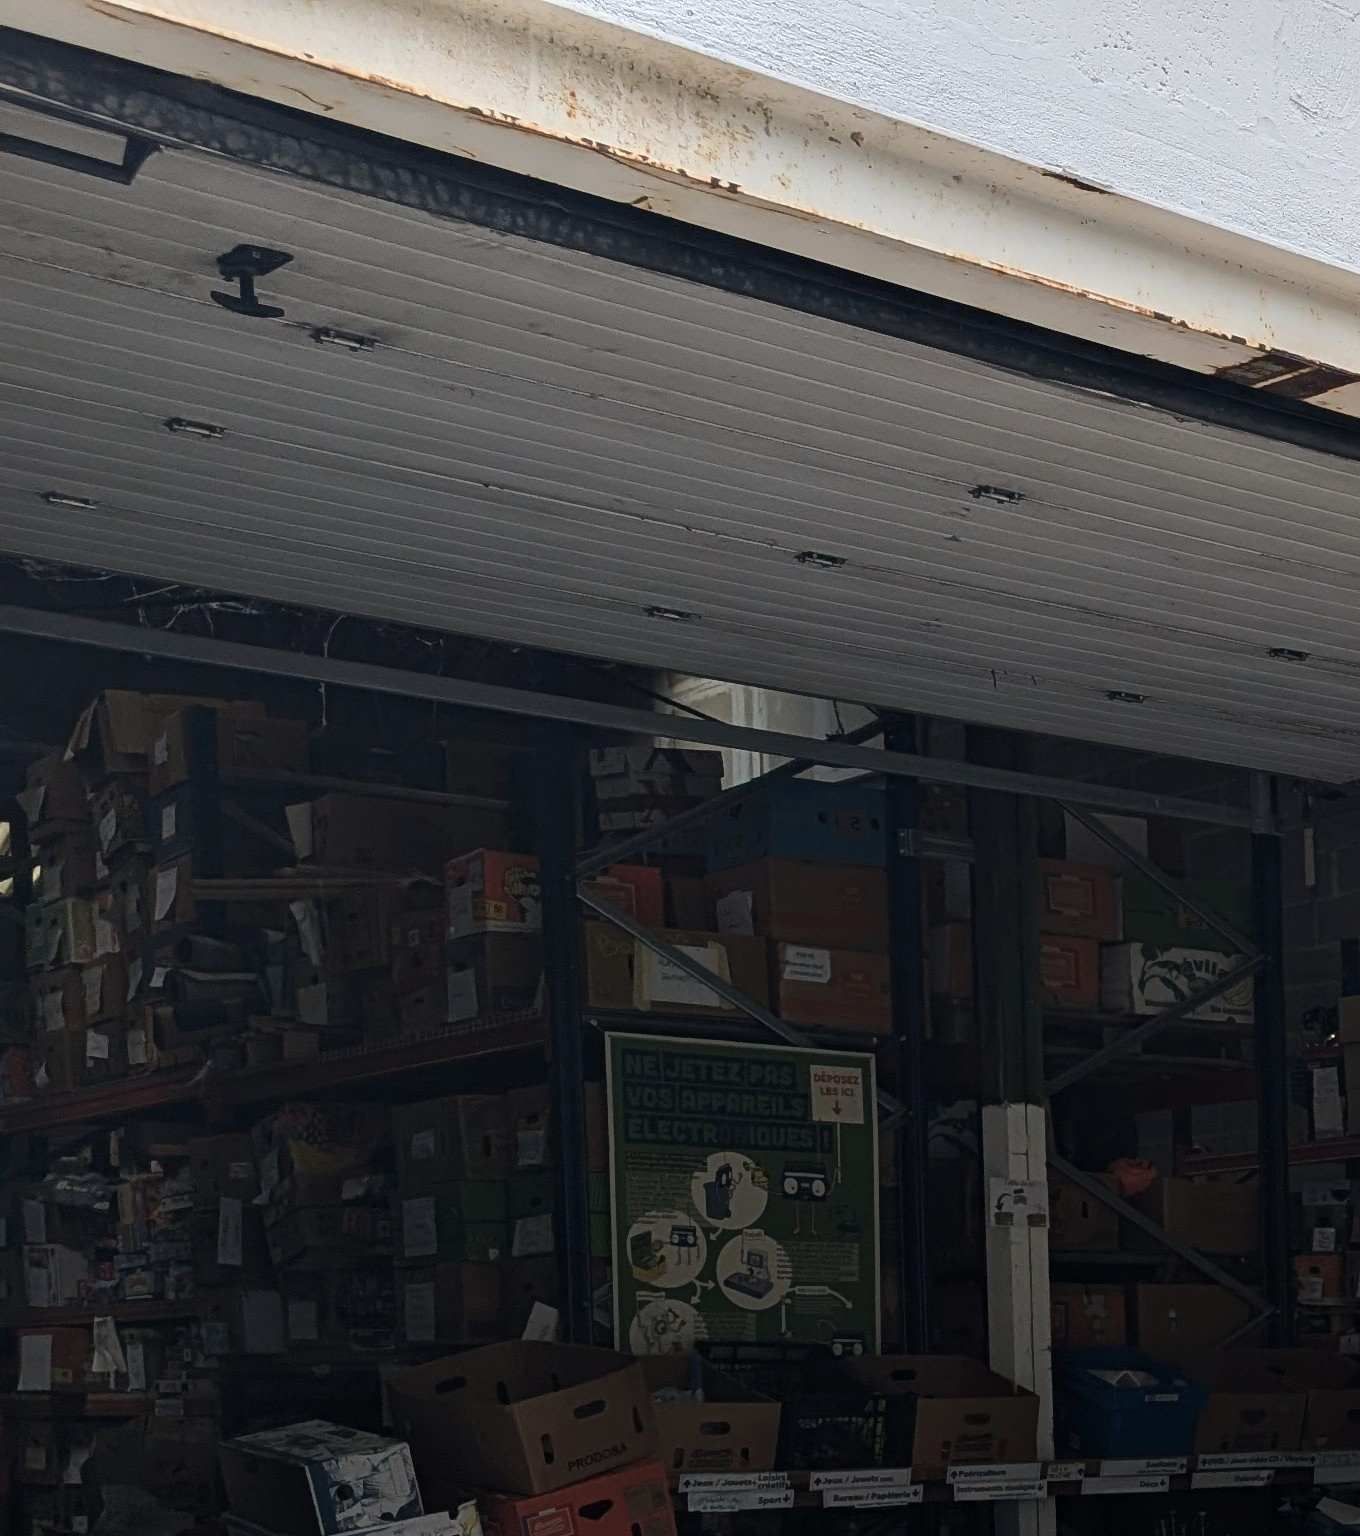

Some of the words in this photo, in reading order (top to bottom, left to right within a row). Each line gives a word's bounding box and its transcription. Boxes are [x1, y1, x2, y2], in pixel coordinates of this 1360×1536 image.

[625, 1052, 657, 1078] NE
[666, 1056, 741, 1082] JETEZ
[749, 1060, 794, 1085] PAS
[814, 1071, 860, 1086] DÉPOSEZ
[820, 1087, 838, 1097] LES
[840, 1088, 854, 1098] ICI
[626, 1086, 674, 1109] VOS
[679, 1089, 803, 1118] APPAREILS
[758, 1496, 782, 1505] Sport
